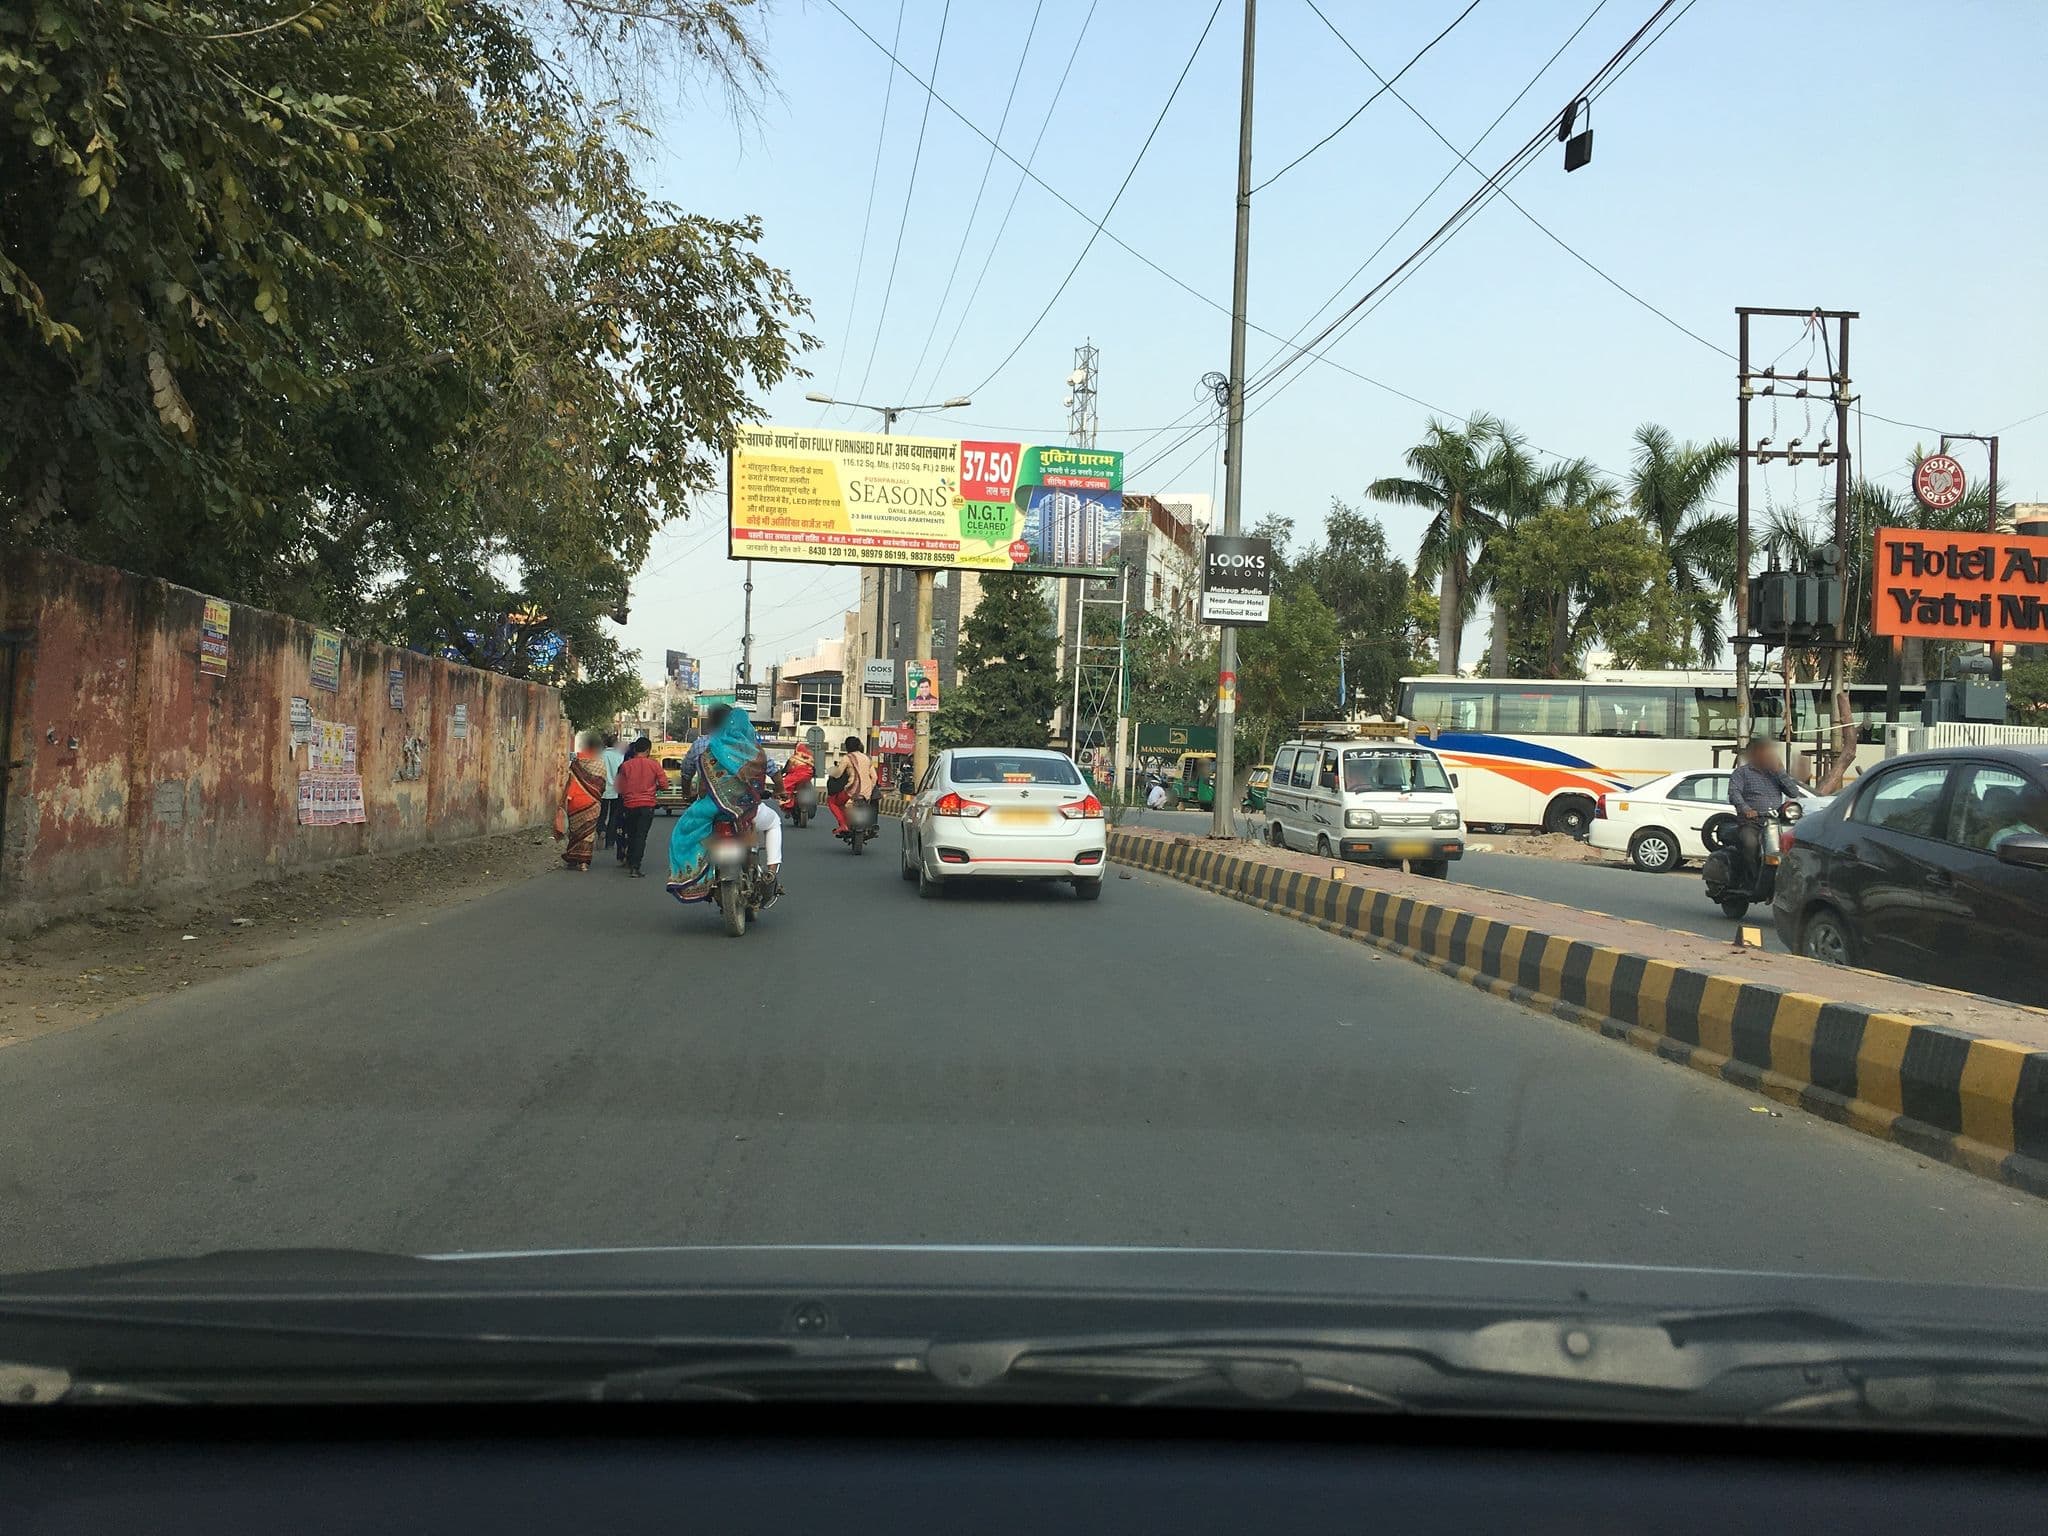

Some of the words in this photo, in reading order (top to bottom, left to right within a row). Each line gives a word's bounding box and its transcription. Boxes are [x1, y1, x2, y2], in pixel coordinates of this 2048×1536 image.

[746, 431, 773, 447] आपके
[775, 432, 799, 449] सपनों
[800, 437, 811, 450] का
[812, 438, 833, 451] FULLY
[835, 439, 874, 455] FURNISHED
[876, 442, 893, 456] FLAT
[895, 444, 909, 457] अब
[911, 445, 947, 460] दयालबाग
[949, 443, 957, 460] में
[1040, 449, 1077, 466] बुकिंग
[843, 459, 863, 467] 116.12
[892, 462, 909, 471] (1250
[935, 464, 939, 472] 2
[941, 464, 955, 473] BHK
[1925, 460, 1956, 474] COSTA
[850, 481, 947, 507] SEASONS
[1922, 486, 1959, 504] COFFEE
[967, 504, 1008, 521] N.G.T.
[967, 521, 1006, 531] CLEARED
[829, 547, 841, 556] 120
[861, 549, 882, 559] 98979
[910, 552, 931, 561] 98378
[1210, 553, 1265, 568] LOOKS
[1885, 541, 1995, 582] Hotel
[1210, 568, 1264, 577] SALON
[1210, 586, 1239, 594] Makeup
[1240, 587, 1262, 595] Studio
[1209, 608, 1243, 616] Fatehabad
[1887, 587, 1992, 627] Yatri
[879, 731, 897, 748] OYO
[1141, 746, 1182, 754] MANSINGH
